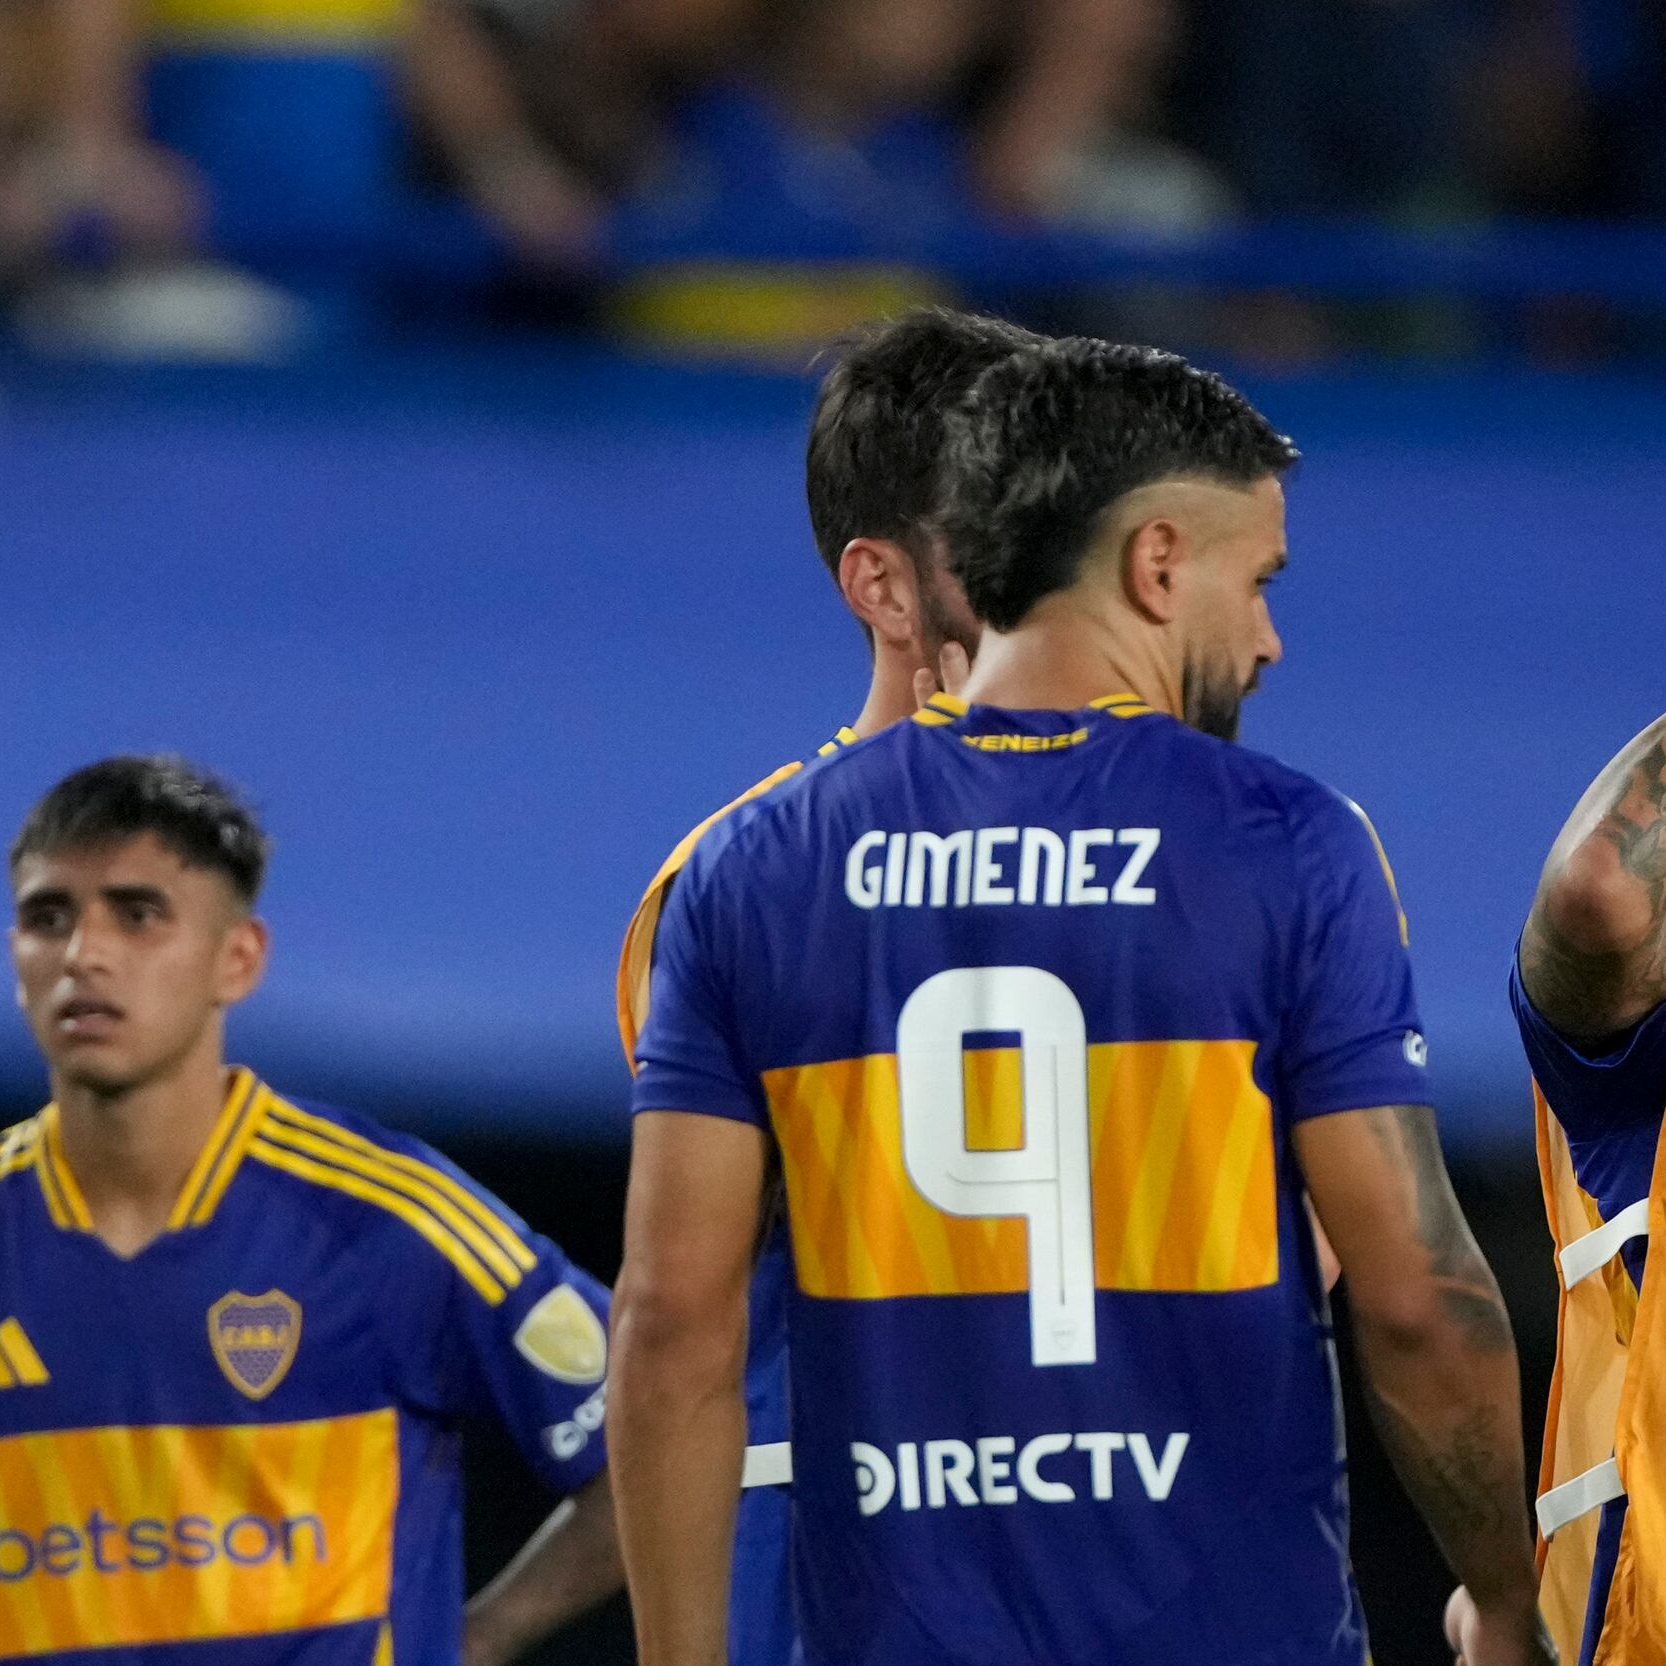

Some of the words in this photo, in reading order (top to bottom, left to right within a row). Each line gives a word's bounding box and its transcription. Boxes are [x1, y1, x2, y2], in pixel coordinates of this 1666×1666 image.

[844, 826, 1161, 909] GIMENEZ
[896, 966, 1097, 1368] 9
[849, 1431, 1191, 1517] DIRECTV
